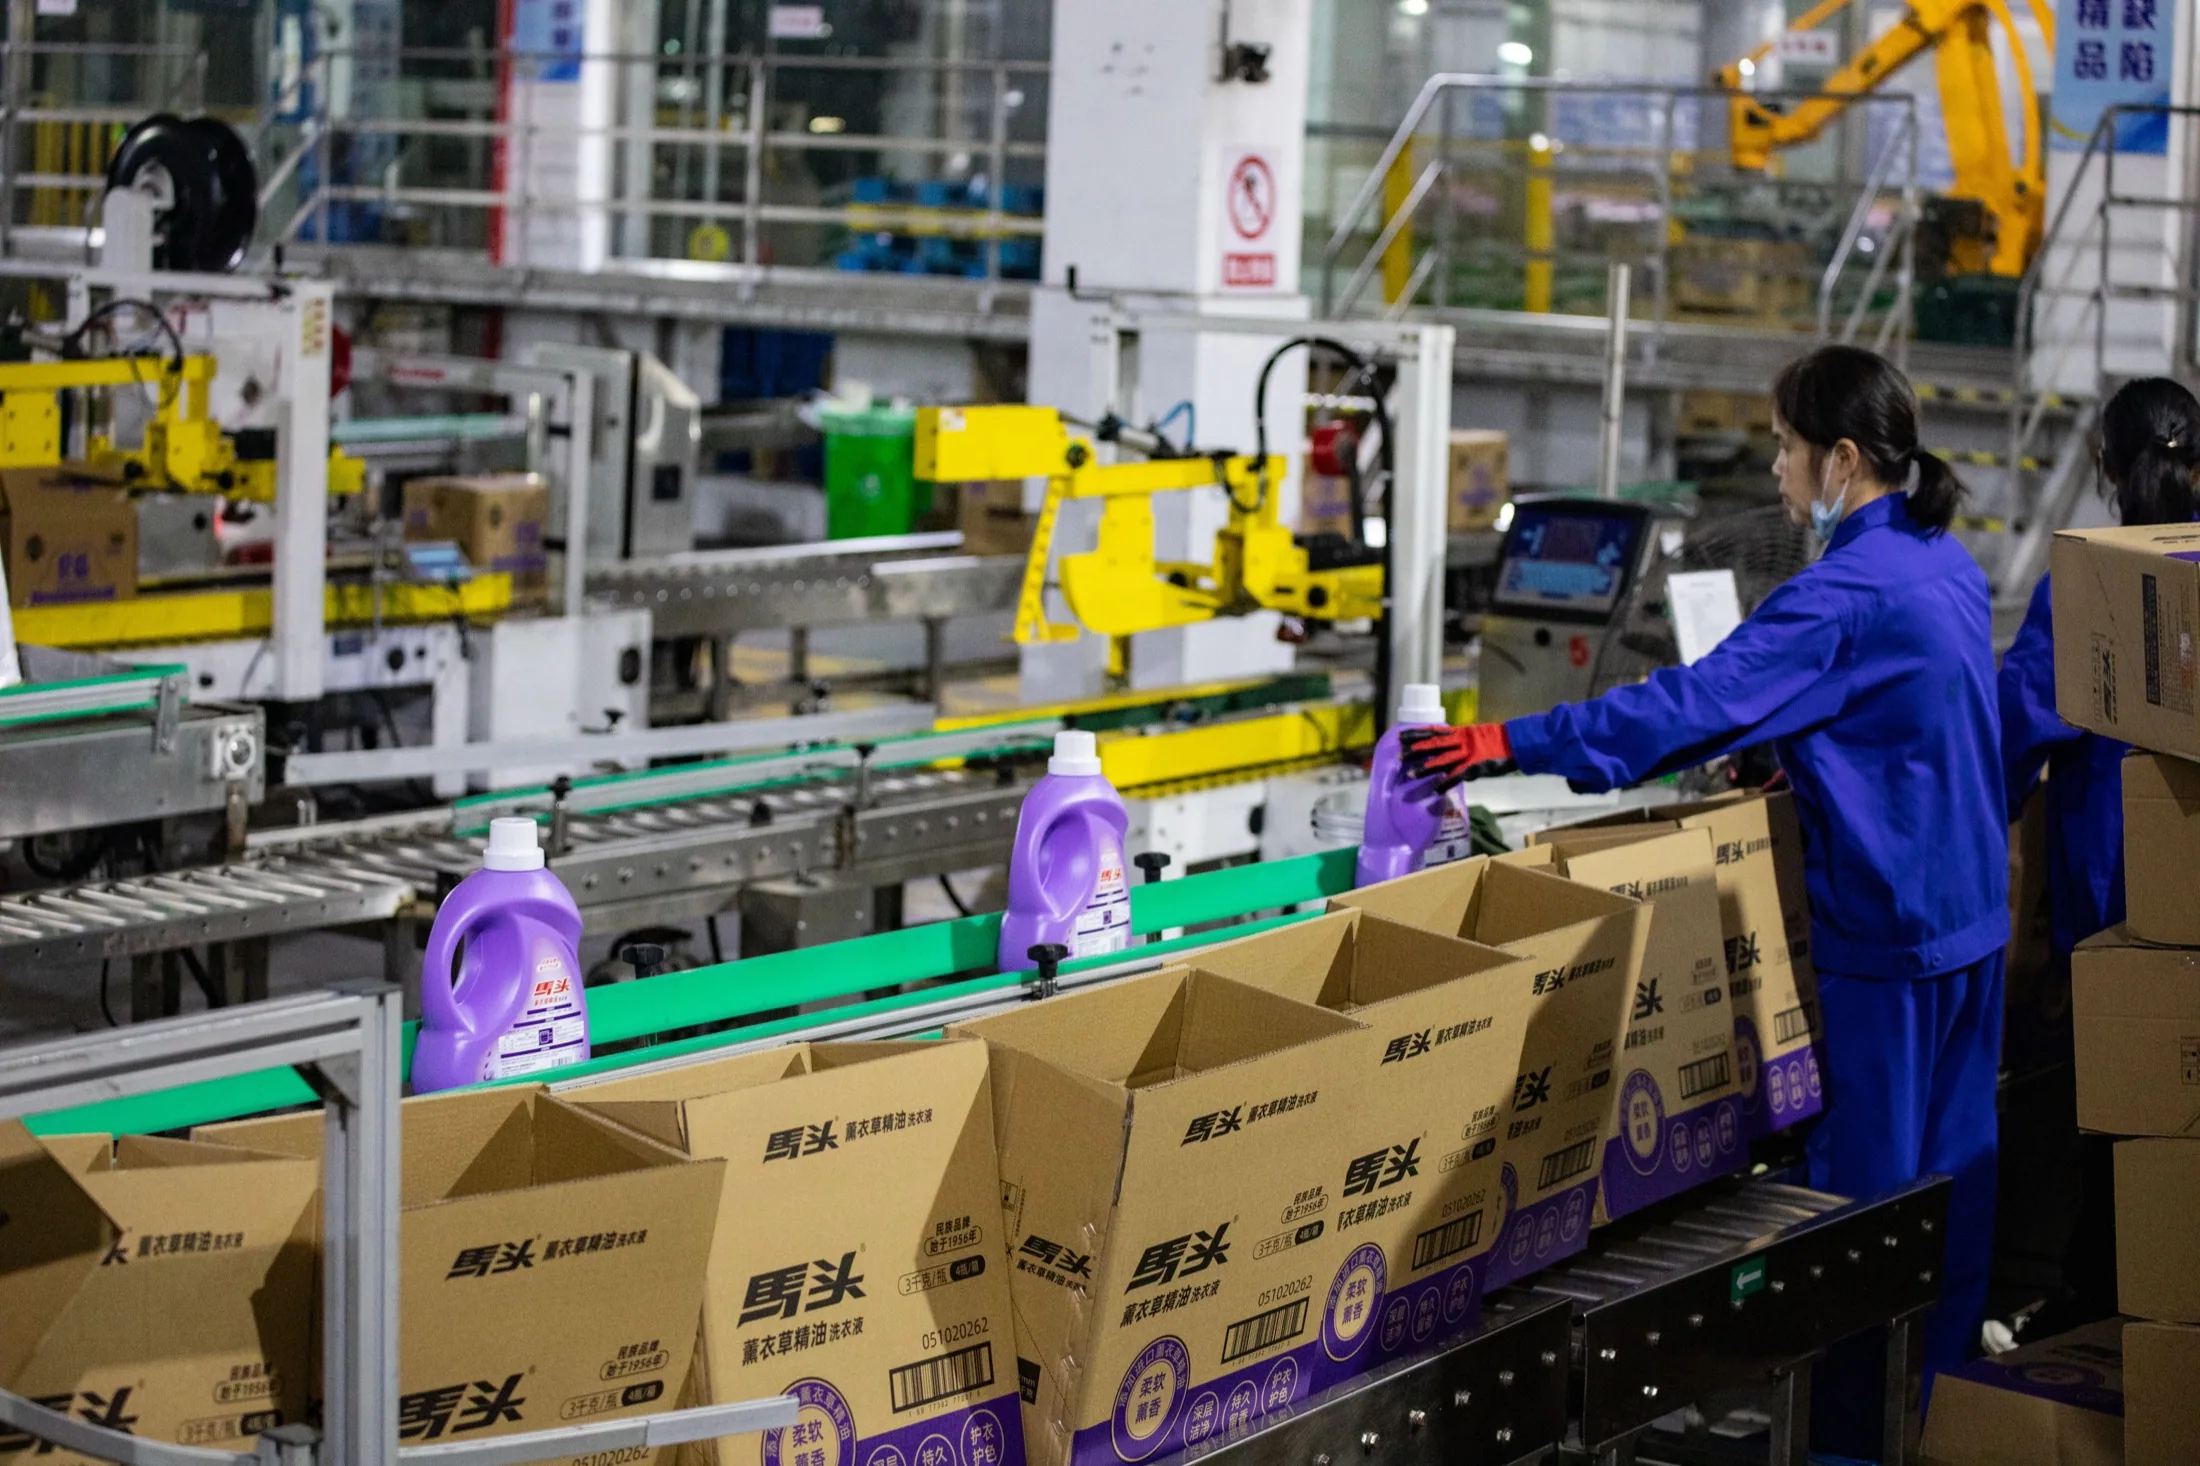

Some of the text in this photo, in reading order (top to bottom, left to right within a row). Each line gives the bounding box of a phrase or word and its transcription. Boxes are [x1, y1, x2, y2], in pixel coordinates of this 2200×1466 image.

[1380, 1028, 1432, 1067] 馬头
[1180, 1105, 1243, 1148] 馬头
[762, 1119, 840, 1165] 馬头
[1342, 1137, 1422, 1199] 馬头
[1293, 1185, 1323, 1206] 民族品牌
[1284, 1197, 1325, 1221] 始于1956年
[935, 1215, 971, 1237] 民族品牌
[929, 1228, 977, 1253] 始于1956年
[445, 1237, 537, 1281] 馬头
[1018, 1234, 1092, 1281] 馬头
[1123, 1221, 1232, 1296] 馬头
[736, 1250, 868, 1330] 馬头
[904, 1268, 948, 1292] 3千克/瓶
[1257, 1274, 1314, 1308] 051020262
[1345, 1276, 1368, 1302] 柔软
[921, 1316, 990, 1350] 051020262
[604, 1355, 664, 1379] 始于1956年
[1271, 1367, 1292, 1390] 护衣
[1139, 1372, 1167, 1399] 柔软
[397, 1371, 527, 1441] 馬头
[568, 1393, 618, 1414] 3千克/瓶
[1135, 1396, 1162, 1425] 薰香
[1192, 1399, 1214, 1422] 深层
[1230, 1390, 1251, 1413] 持久
[791, 1419, 824, 1449] 柔软
[970, 1422, 996, 1447] 护衣
[921, 1444, 948, 1466] 持久
[973, 1444, 998, 1466] 护色
